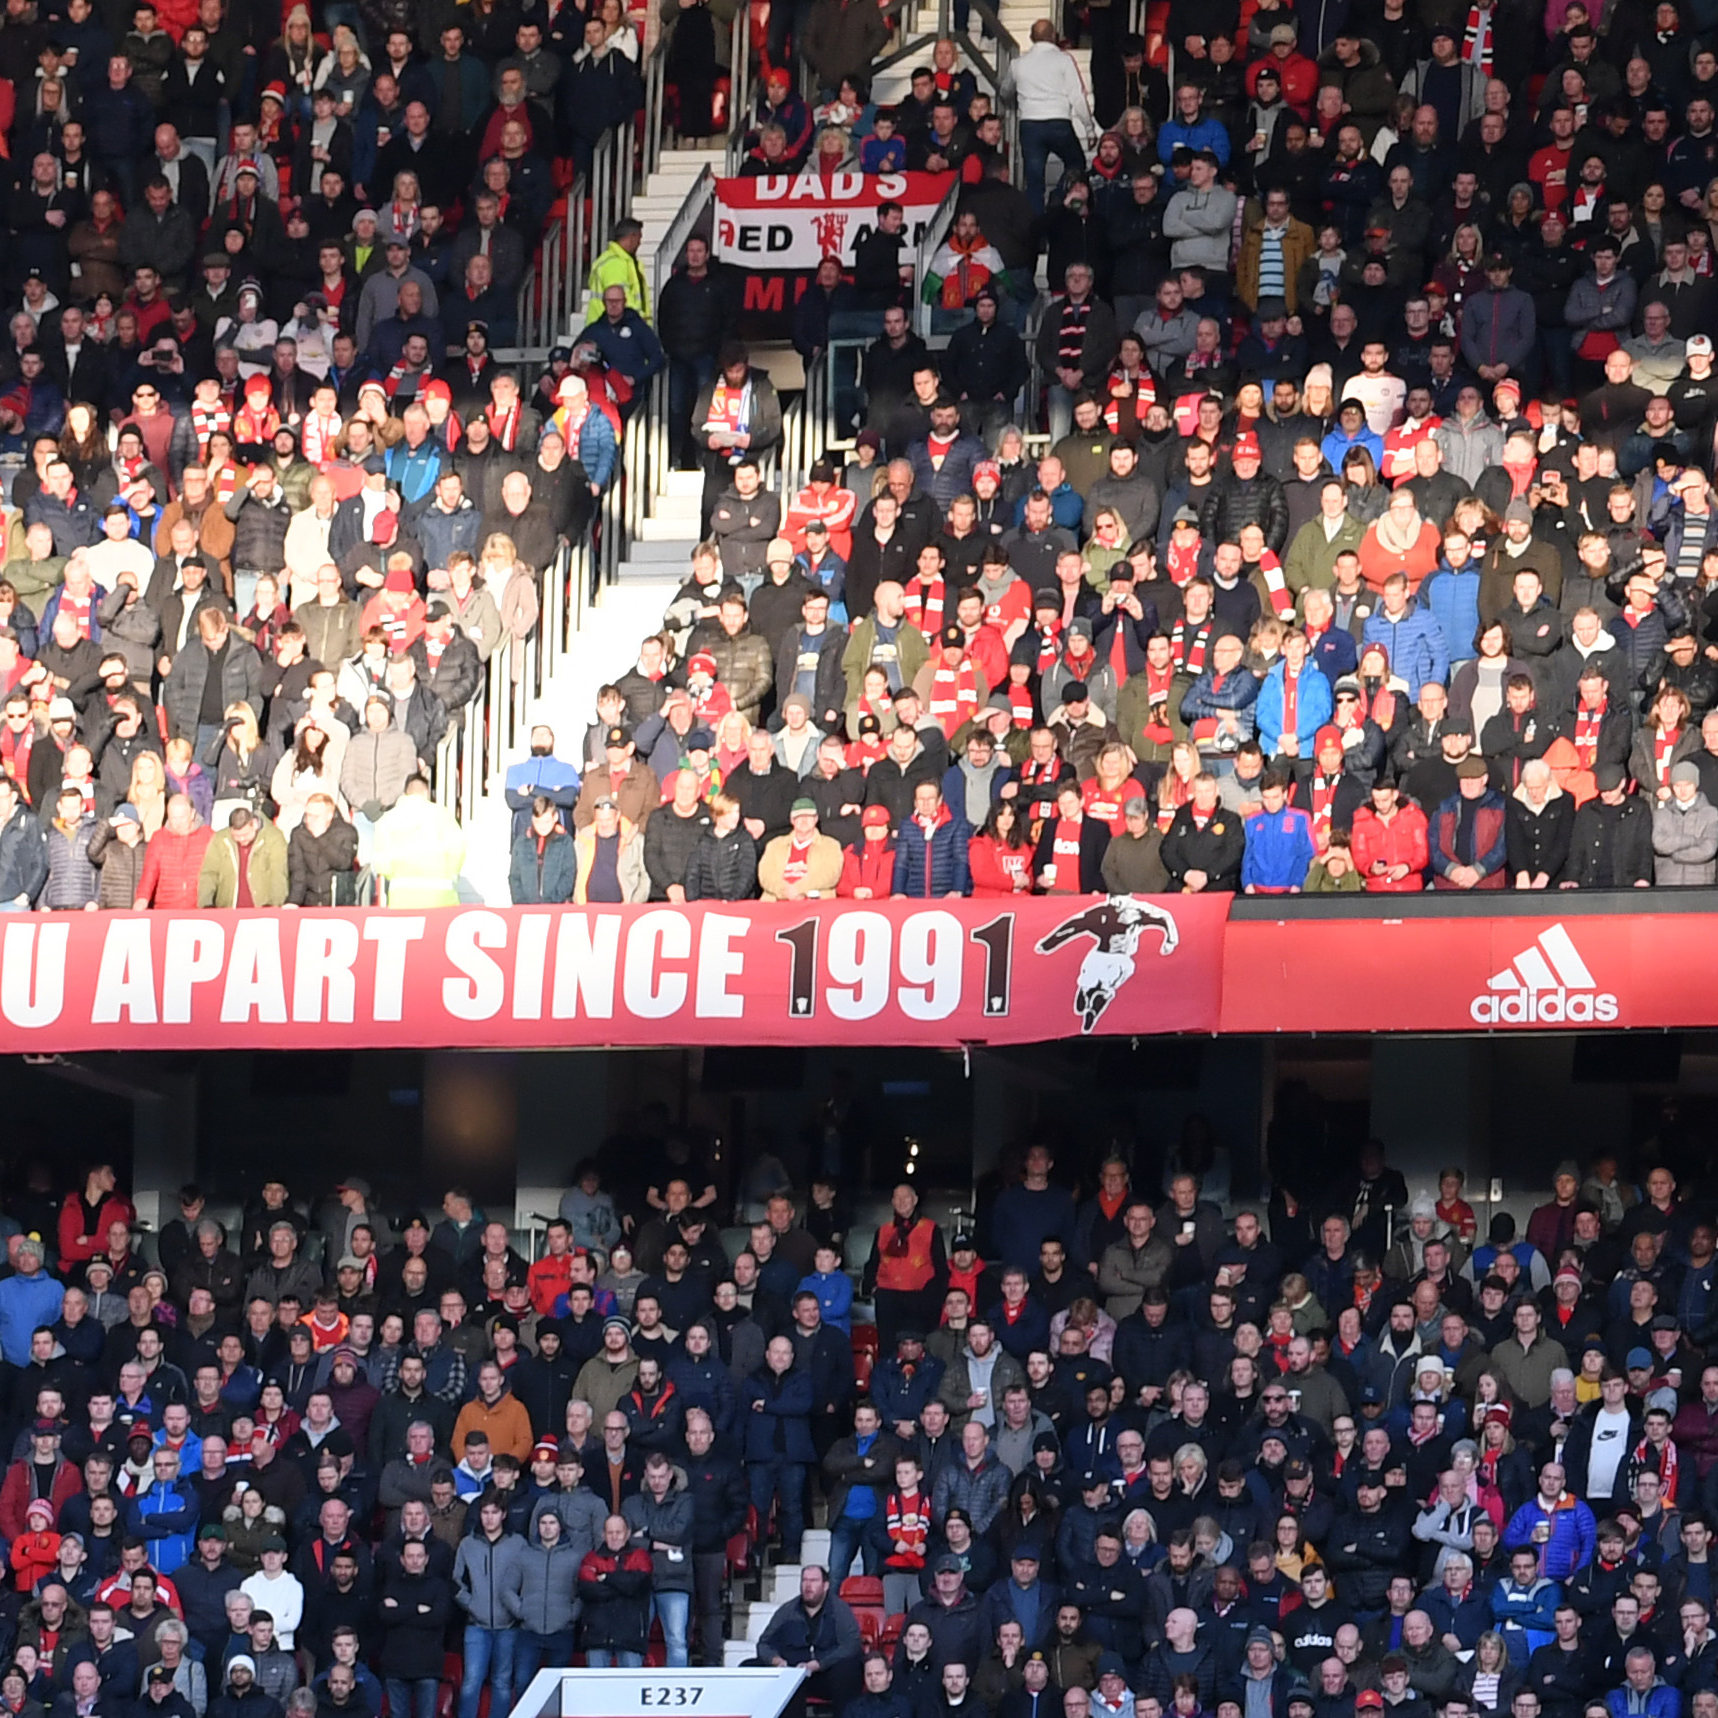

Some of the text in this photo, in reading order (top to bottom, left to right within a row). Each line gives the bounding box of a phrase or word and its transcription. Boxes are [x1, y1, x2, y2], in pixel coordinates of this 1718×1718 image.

[91, 916, 426, 1024] APART
[443, 909, 751, 1020] SINCE
[775, 909, 1015, 1020] 1991
[1471, 990, 1618, 1023] adidas
[1295, 1633, 1332, 1648] adidas
[640, 1687, 704, 1706] E237
